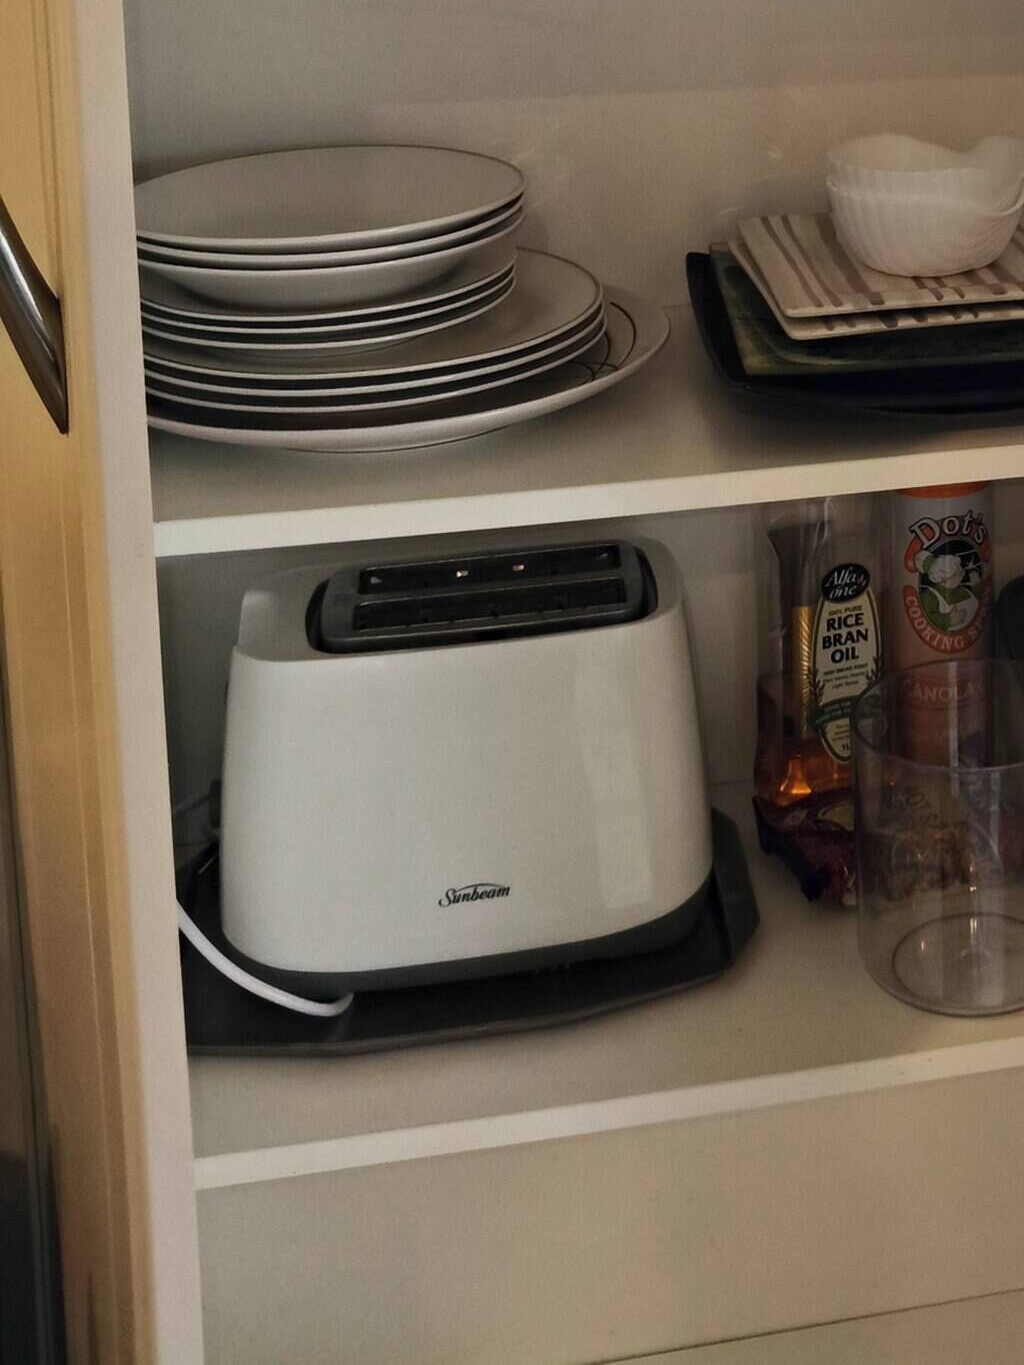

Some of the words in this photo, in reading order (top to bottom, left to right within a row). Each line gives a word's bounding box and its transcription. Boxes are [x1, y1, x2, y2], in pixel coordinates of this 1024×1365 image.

[909, 510, 987, 549] Dot's
[825, 566, 857, 587] Alfa
[828, 585, 858, 600] one
[826, 613, 864, 632] RICE
[905, 595, 965, 652] COOKING
[822, 628, 868, 649] BRAN
[831, 646, 859, 663] OIL
[438, 884, 511, 907] Sunbeam
